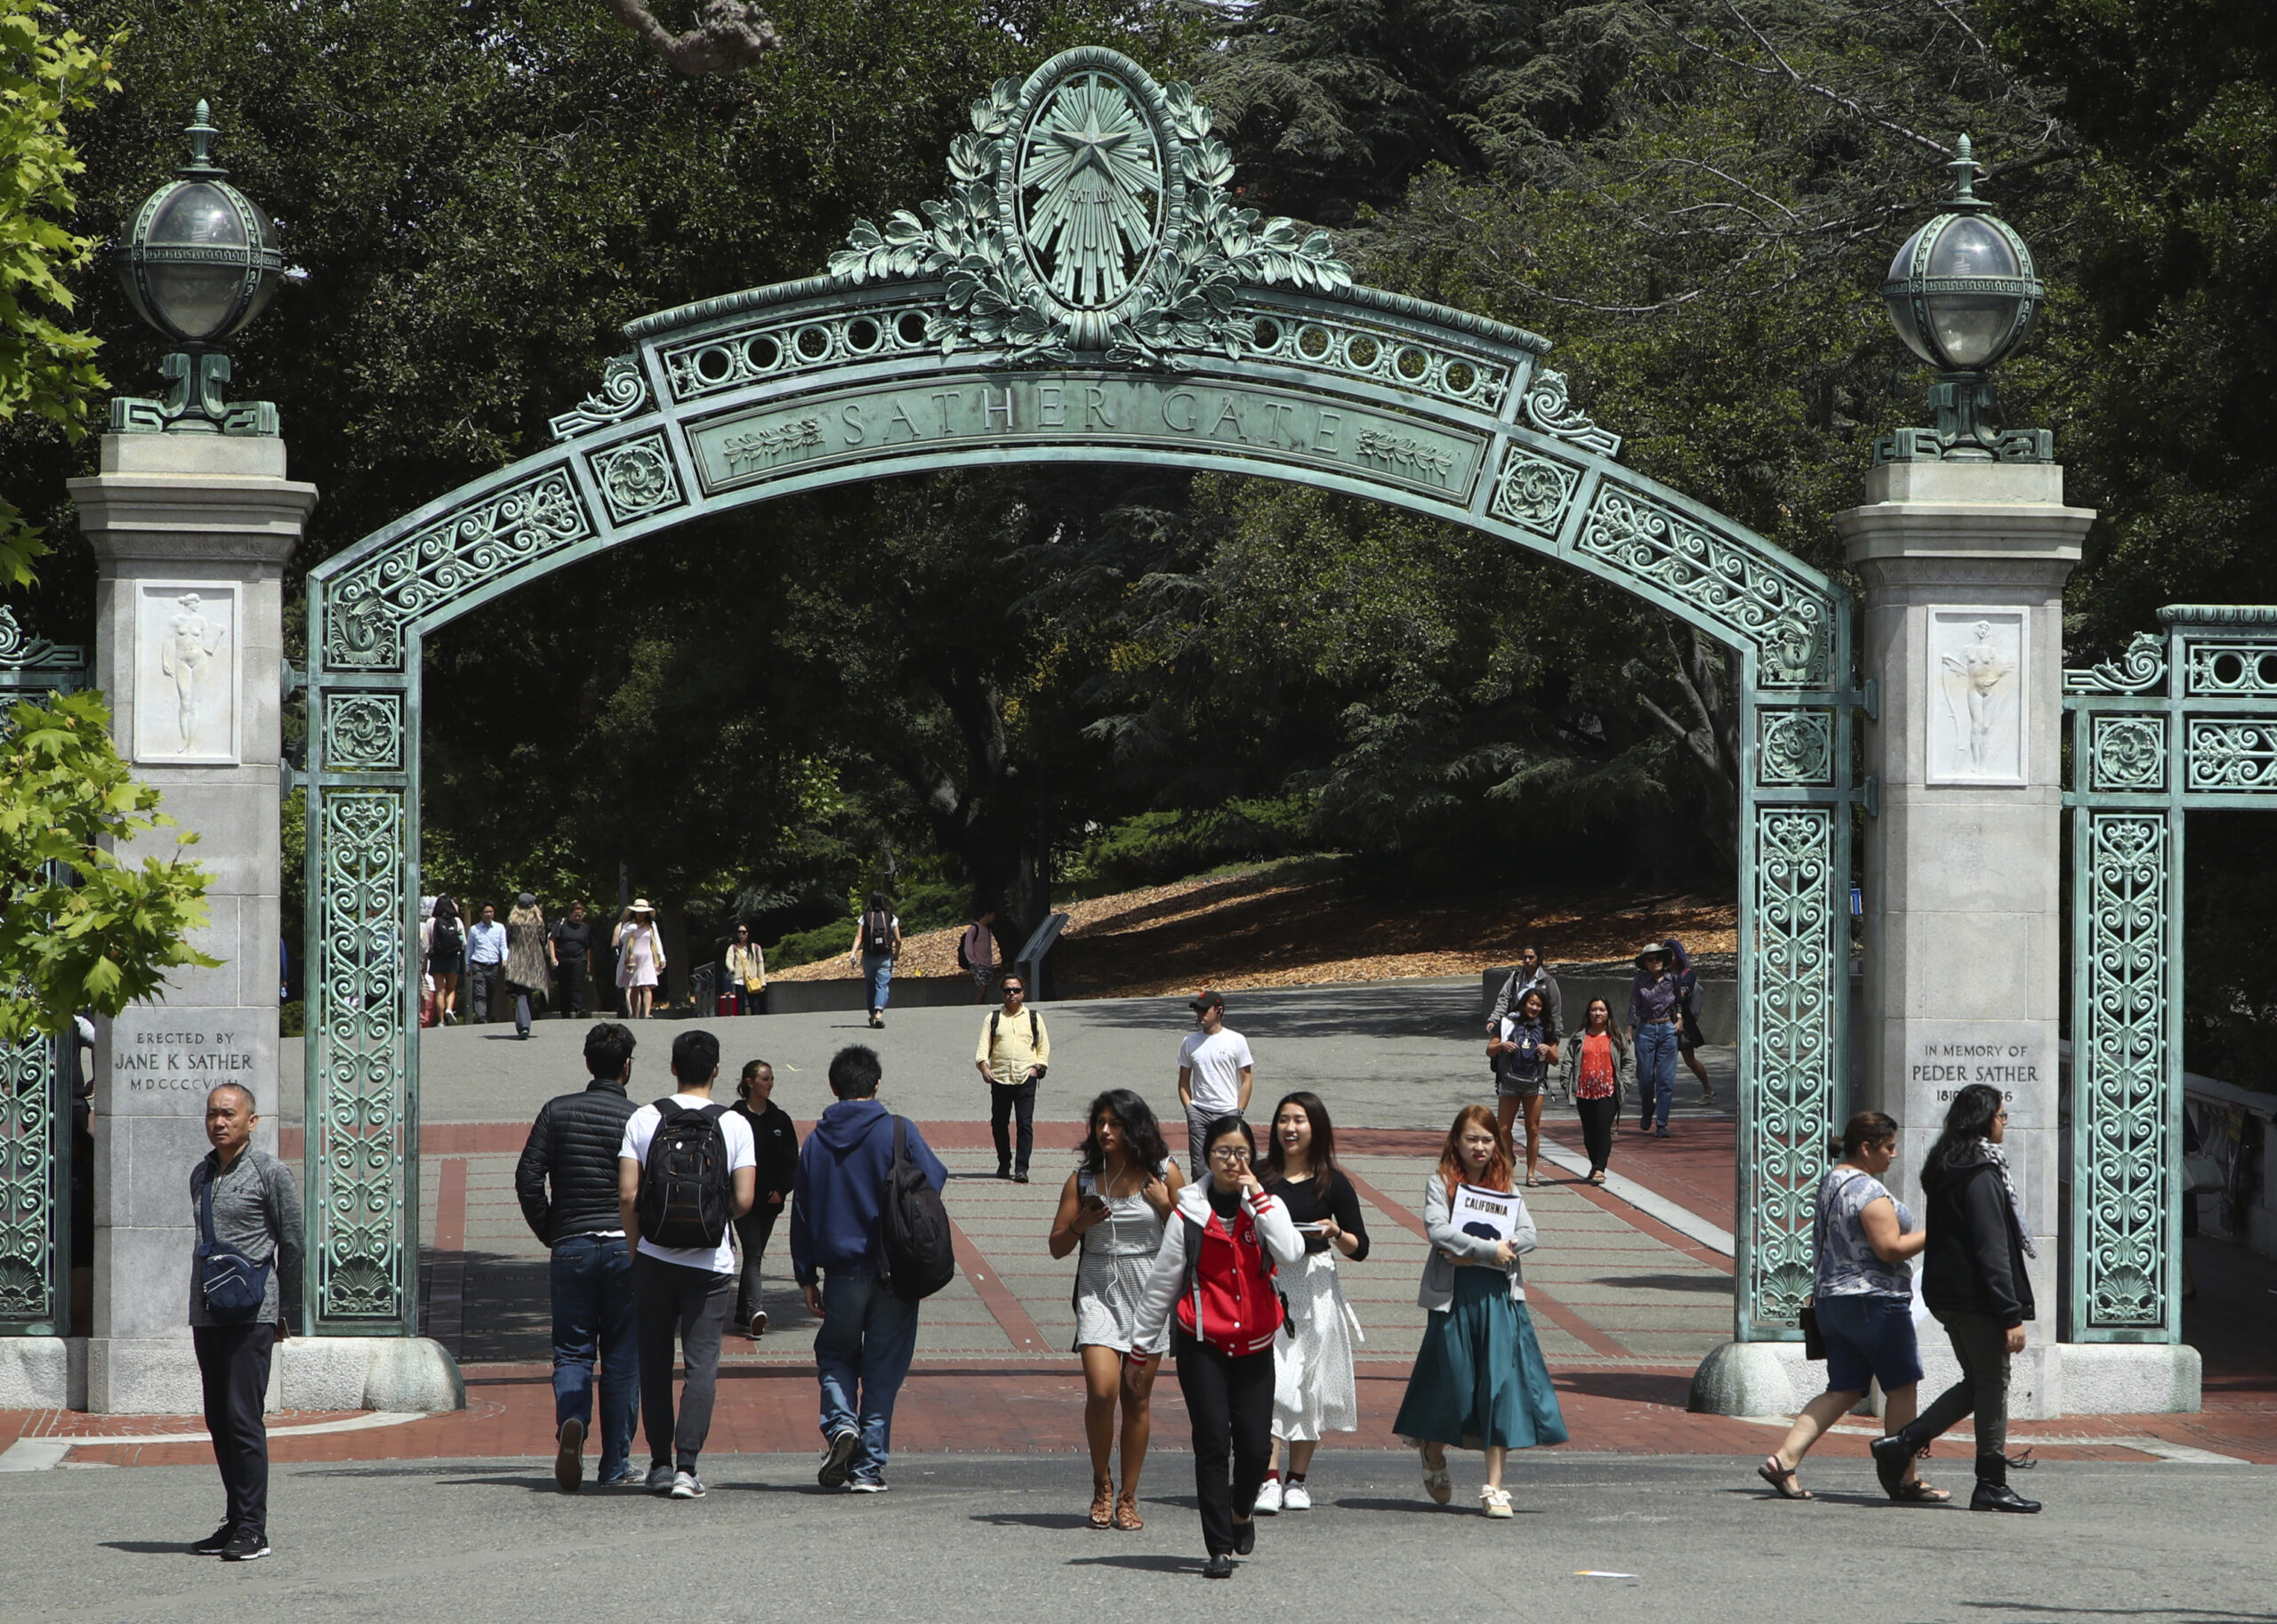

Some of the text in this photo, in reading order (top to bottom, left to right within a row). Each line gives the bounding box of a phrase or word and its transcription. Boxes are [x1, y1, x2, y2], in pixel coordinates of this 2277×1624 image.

[841, 386, 1341, 454] SATHER GATE
[137, 1032, 234, 1044] ERECTED BY
[1925, 1045, 2028, 1057] IN MEMORY OF
[115, 1054, 253, 1070] JANE K SATHER
[1912, 1065, 2040, 1081] PEDER SATHER
[130, 1078, 238, 1090] MDCCCCVI
[1465, 1197, 1508, 1217] CALIFORNIA
